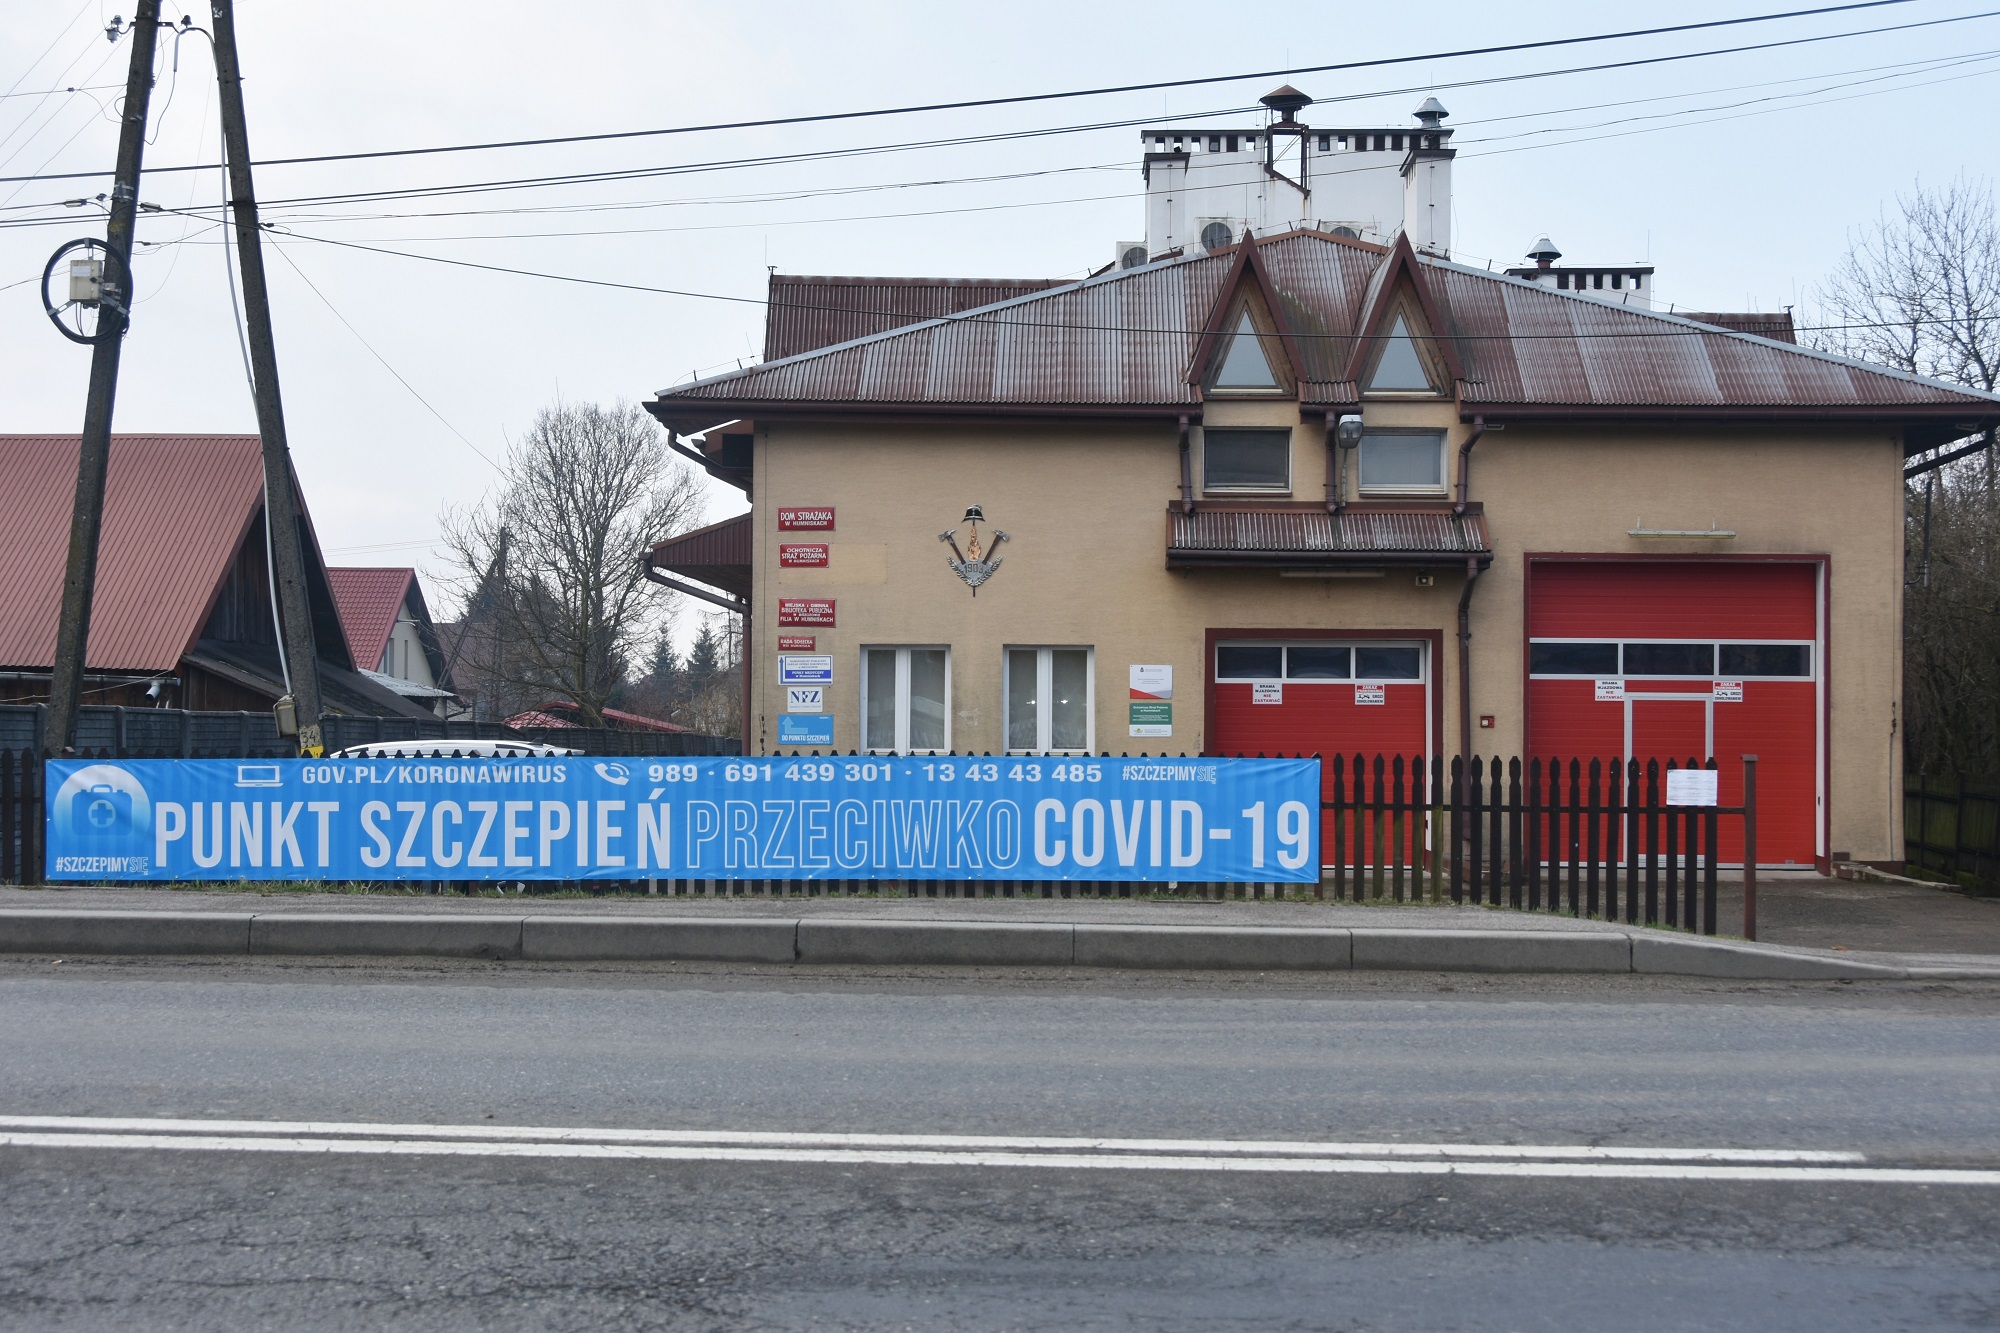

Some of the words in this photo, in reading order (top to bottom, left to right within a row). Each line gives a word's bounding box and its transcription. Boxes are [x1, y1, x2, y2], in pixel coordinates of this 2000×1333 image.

[780, 512, 796, 521] DOM
[797, 511, 833, 521] STRAŻAKA
[964, 563, 984, 574] 1903
[790, 690, 821, 703] NFZ
[301, 730, 316, 743] 34
[781, 734, 789, 742] DO
[301, 763, 568, 784] GOV.PL/KORONAWIRUS
[648, 764, 698, 782] 989
[724, 764, 772, 782] 691
[784, 763, 835, 782] 439
[844, 763, 893, 782] 301
[921, 763, 956, 782] 13
[964, 763, 1000, 782] 43
[1007, 764, 1043, 782] 43
[1051, 764, 1103, 783] 485
[155, 801, 340, 869] PUNKT
[360, 787, 671, 870] SZCZEPIEŃ
[686, 799, 1021, 870] PRZECIWKO
[1034, 798, 1310, 870] COVID-19
